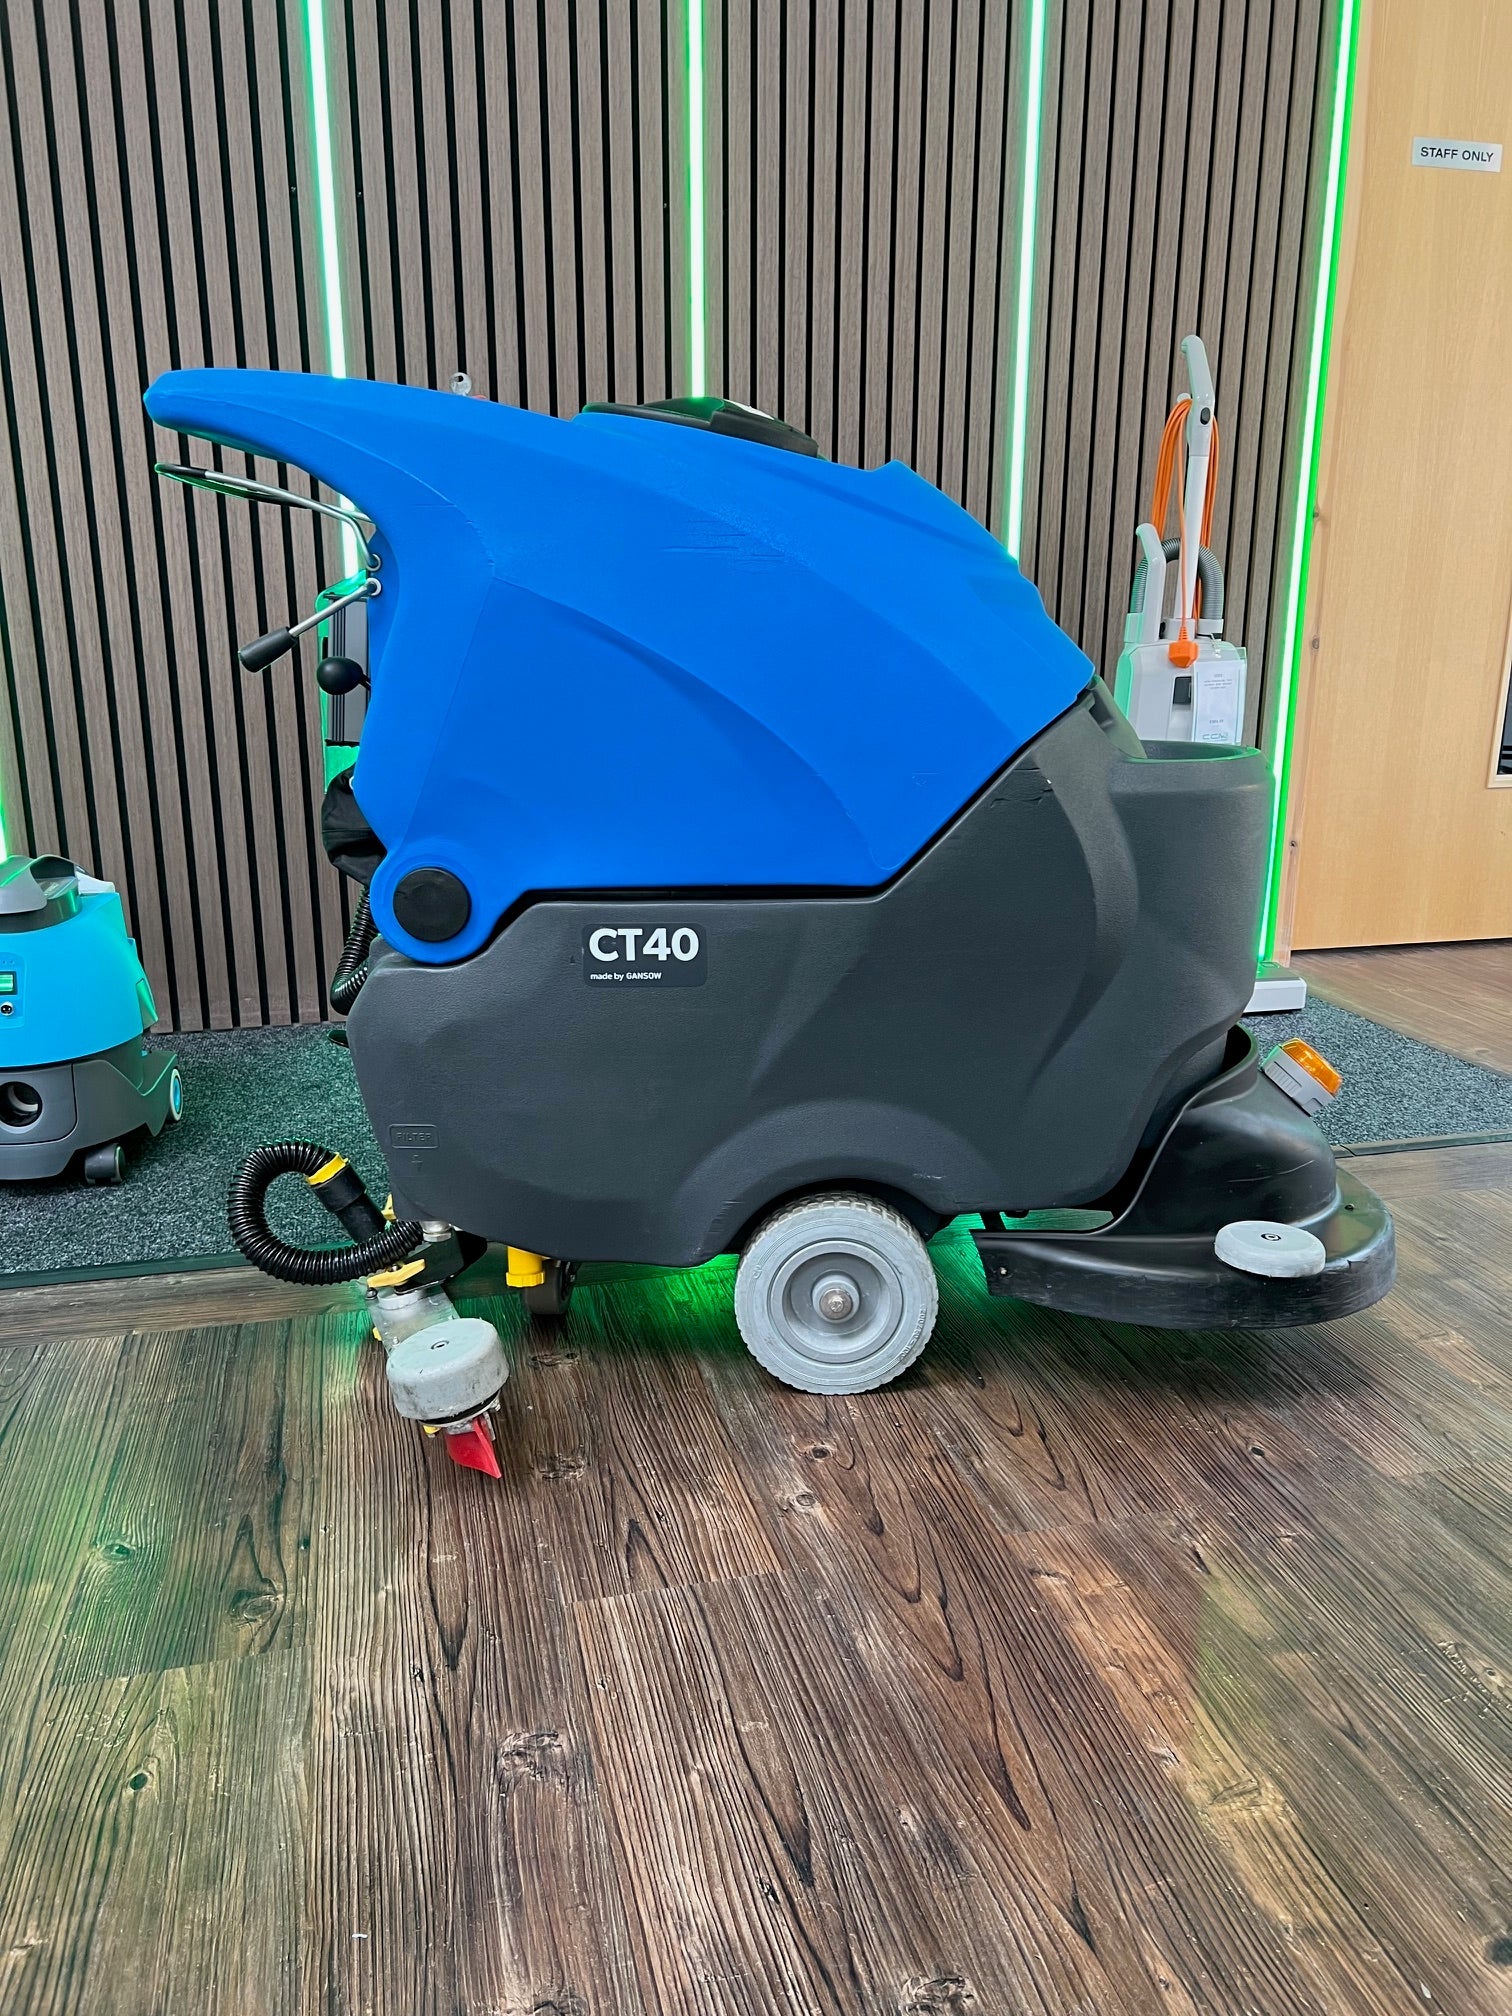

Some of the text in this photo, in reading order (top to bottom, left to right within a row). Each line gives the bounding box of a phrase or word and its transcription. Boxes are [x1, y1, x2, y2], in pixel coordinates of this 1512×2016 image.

[1420, 146, 1494, 162] STAFF ONLY
[588, 927, 700, 962] CT40
[590, 972, 662, 981] made by GANSOW
